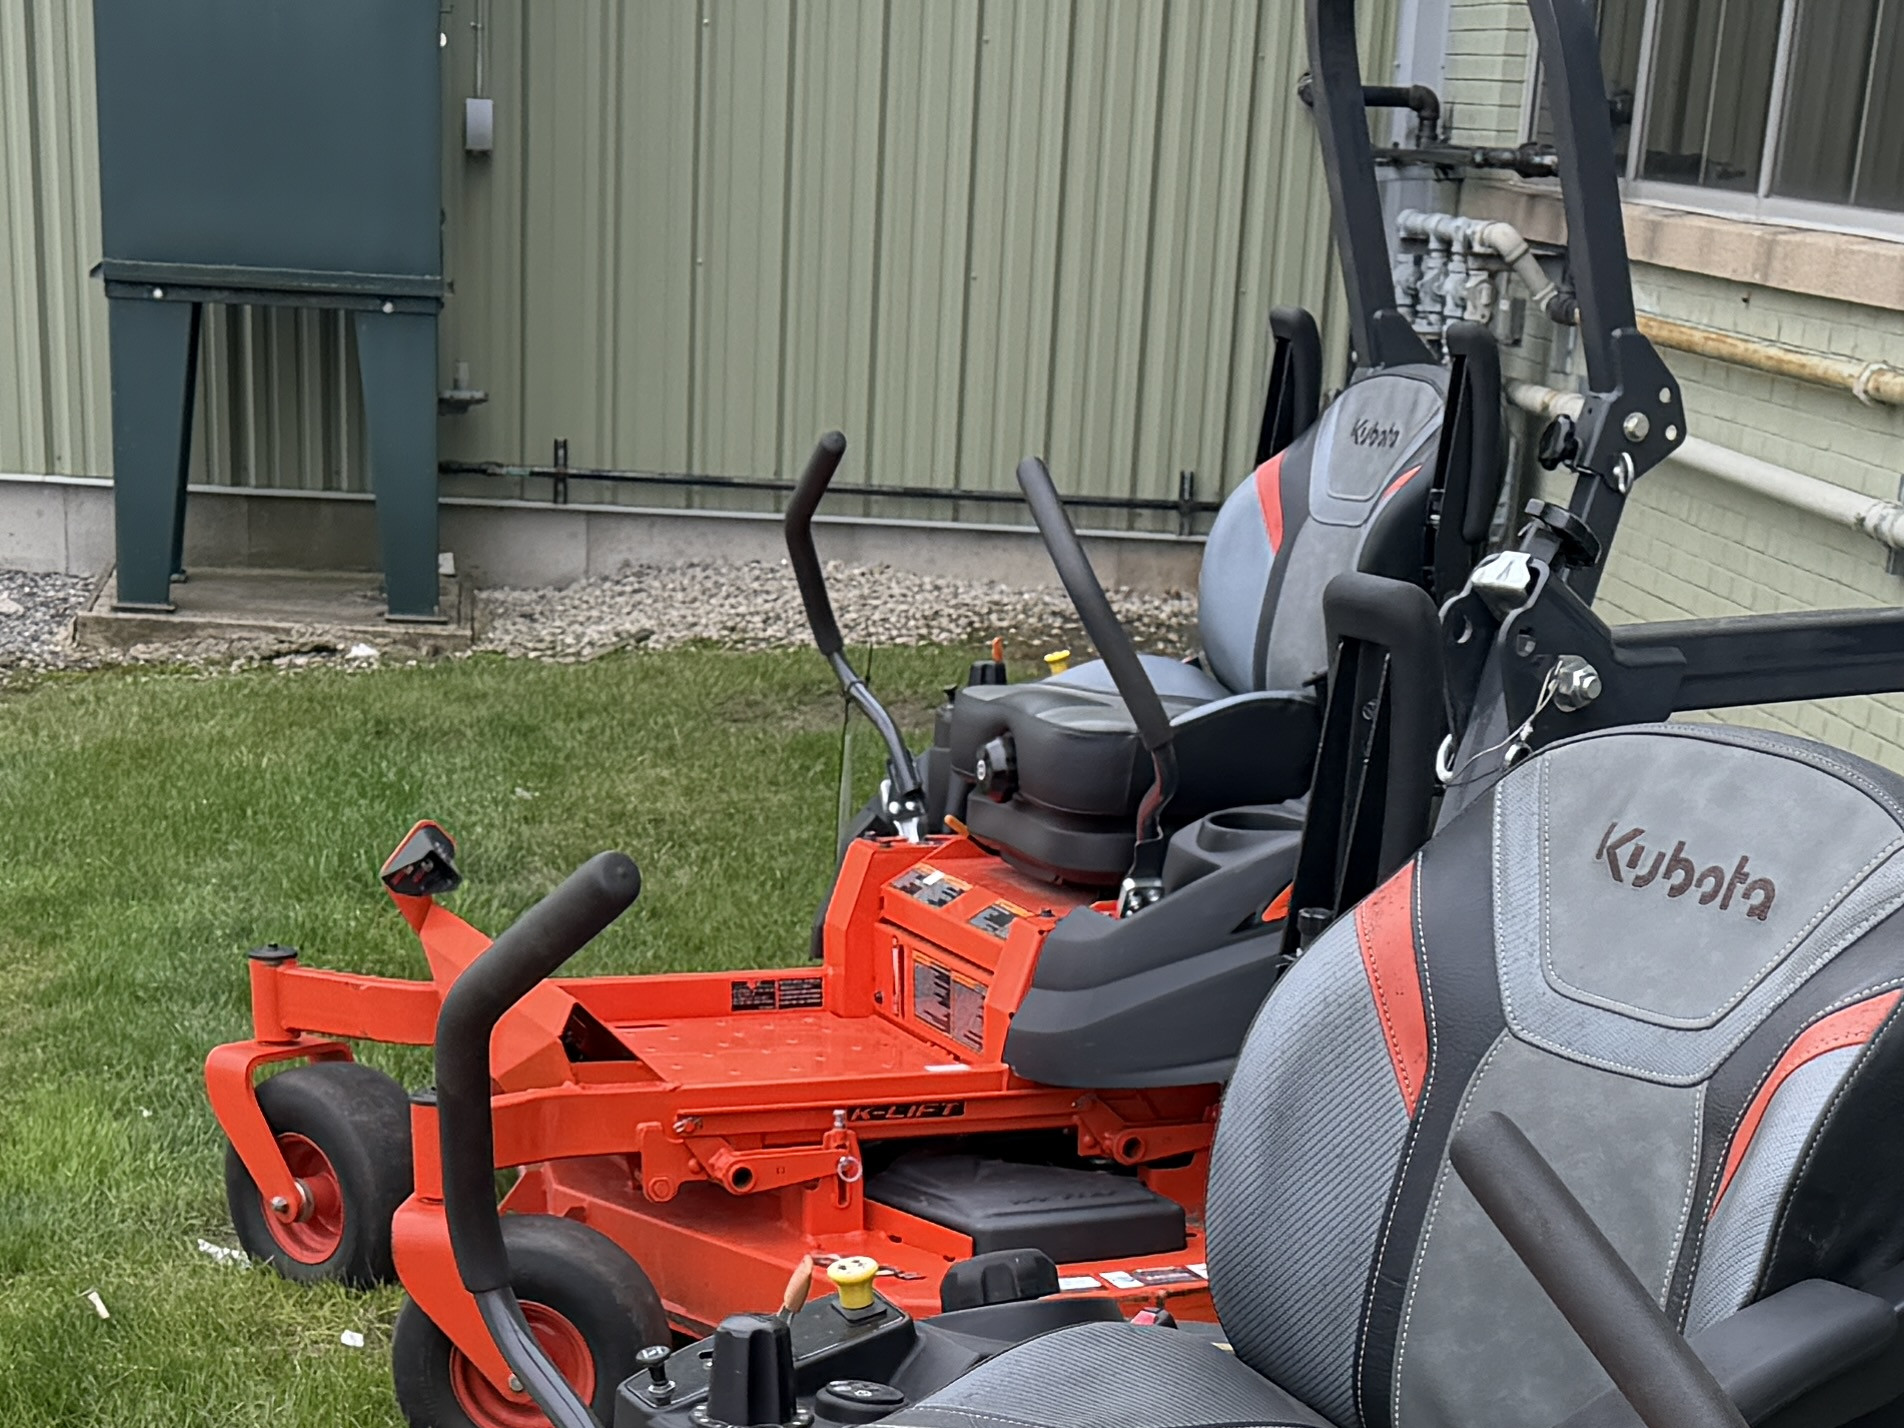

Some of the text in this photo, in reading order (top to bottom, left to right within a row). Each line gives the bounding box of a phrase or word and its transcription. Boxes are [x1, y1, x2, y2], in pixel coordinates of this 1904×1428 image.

[1351, 418, 1400, 448] Kubota
[1595, 822, 1776, 921] Kubota
[850, 1102, 960, 1121] K-LIFT
